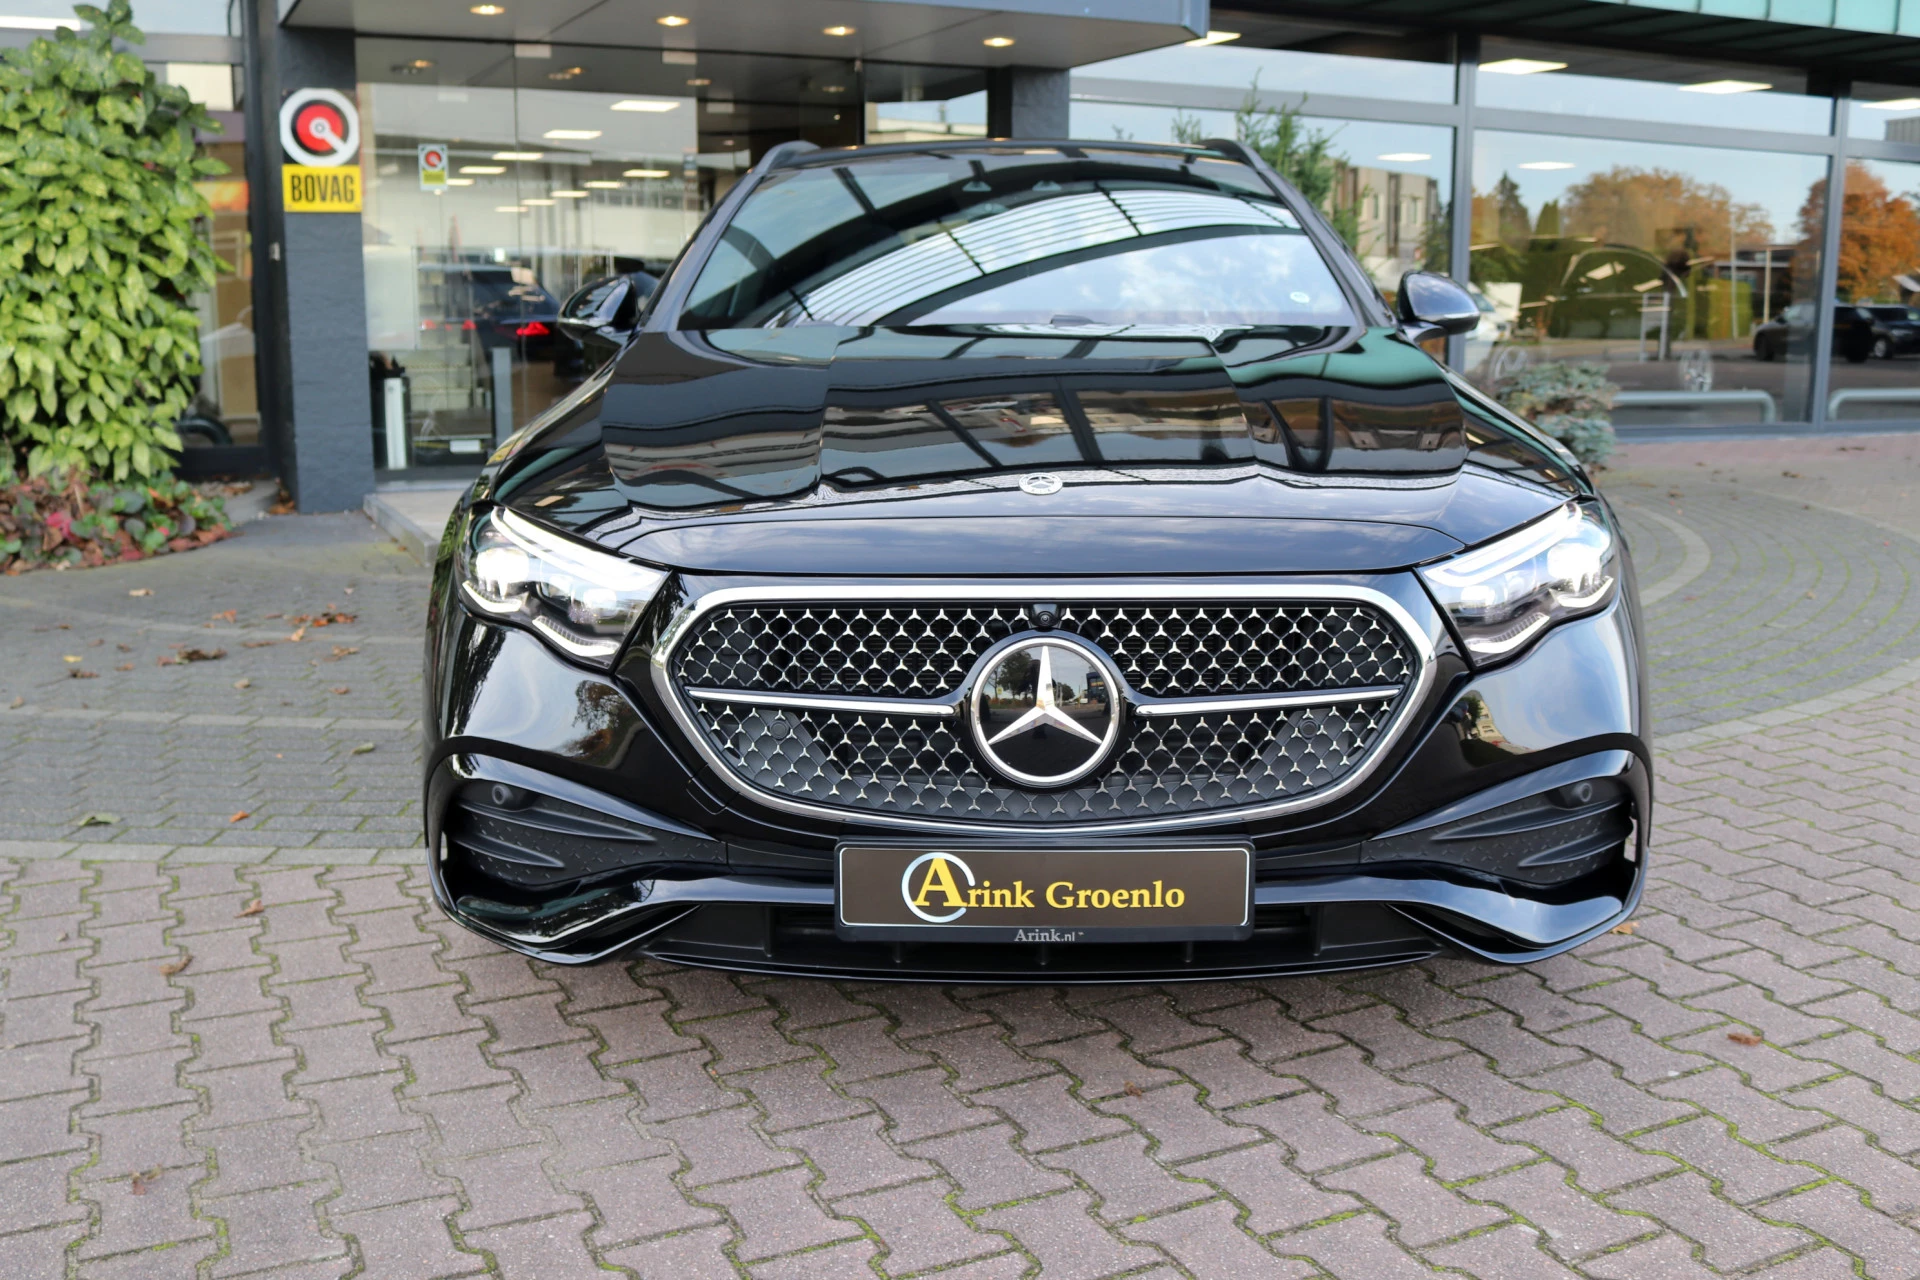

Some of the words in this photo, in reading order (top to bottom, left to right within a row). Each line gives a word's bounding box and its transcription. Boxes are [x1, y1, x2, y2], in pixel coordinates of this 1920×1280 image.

[291, 175, 354, 203] BOVAG
[915, 857, 1035, 909] Arink
[1045, 879, 1185, 909] Groenlo
[1014, 928, 1076, 942] Arink.nl
